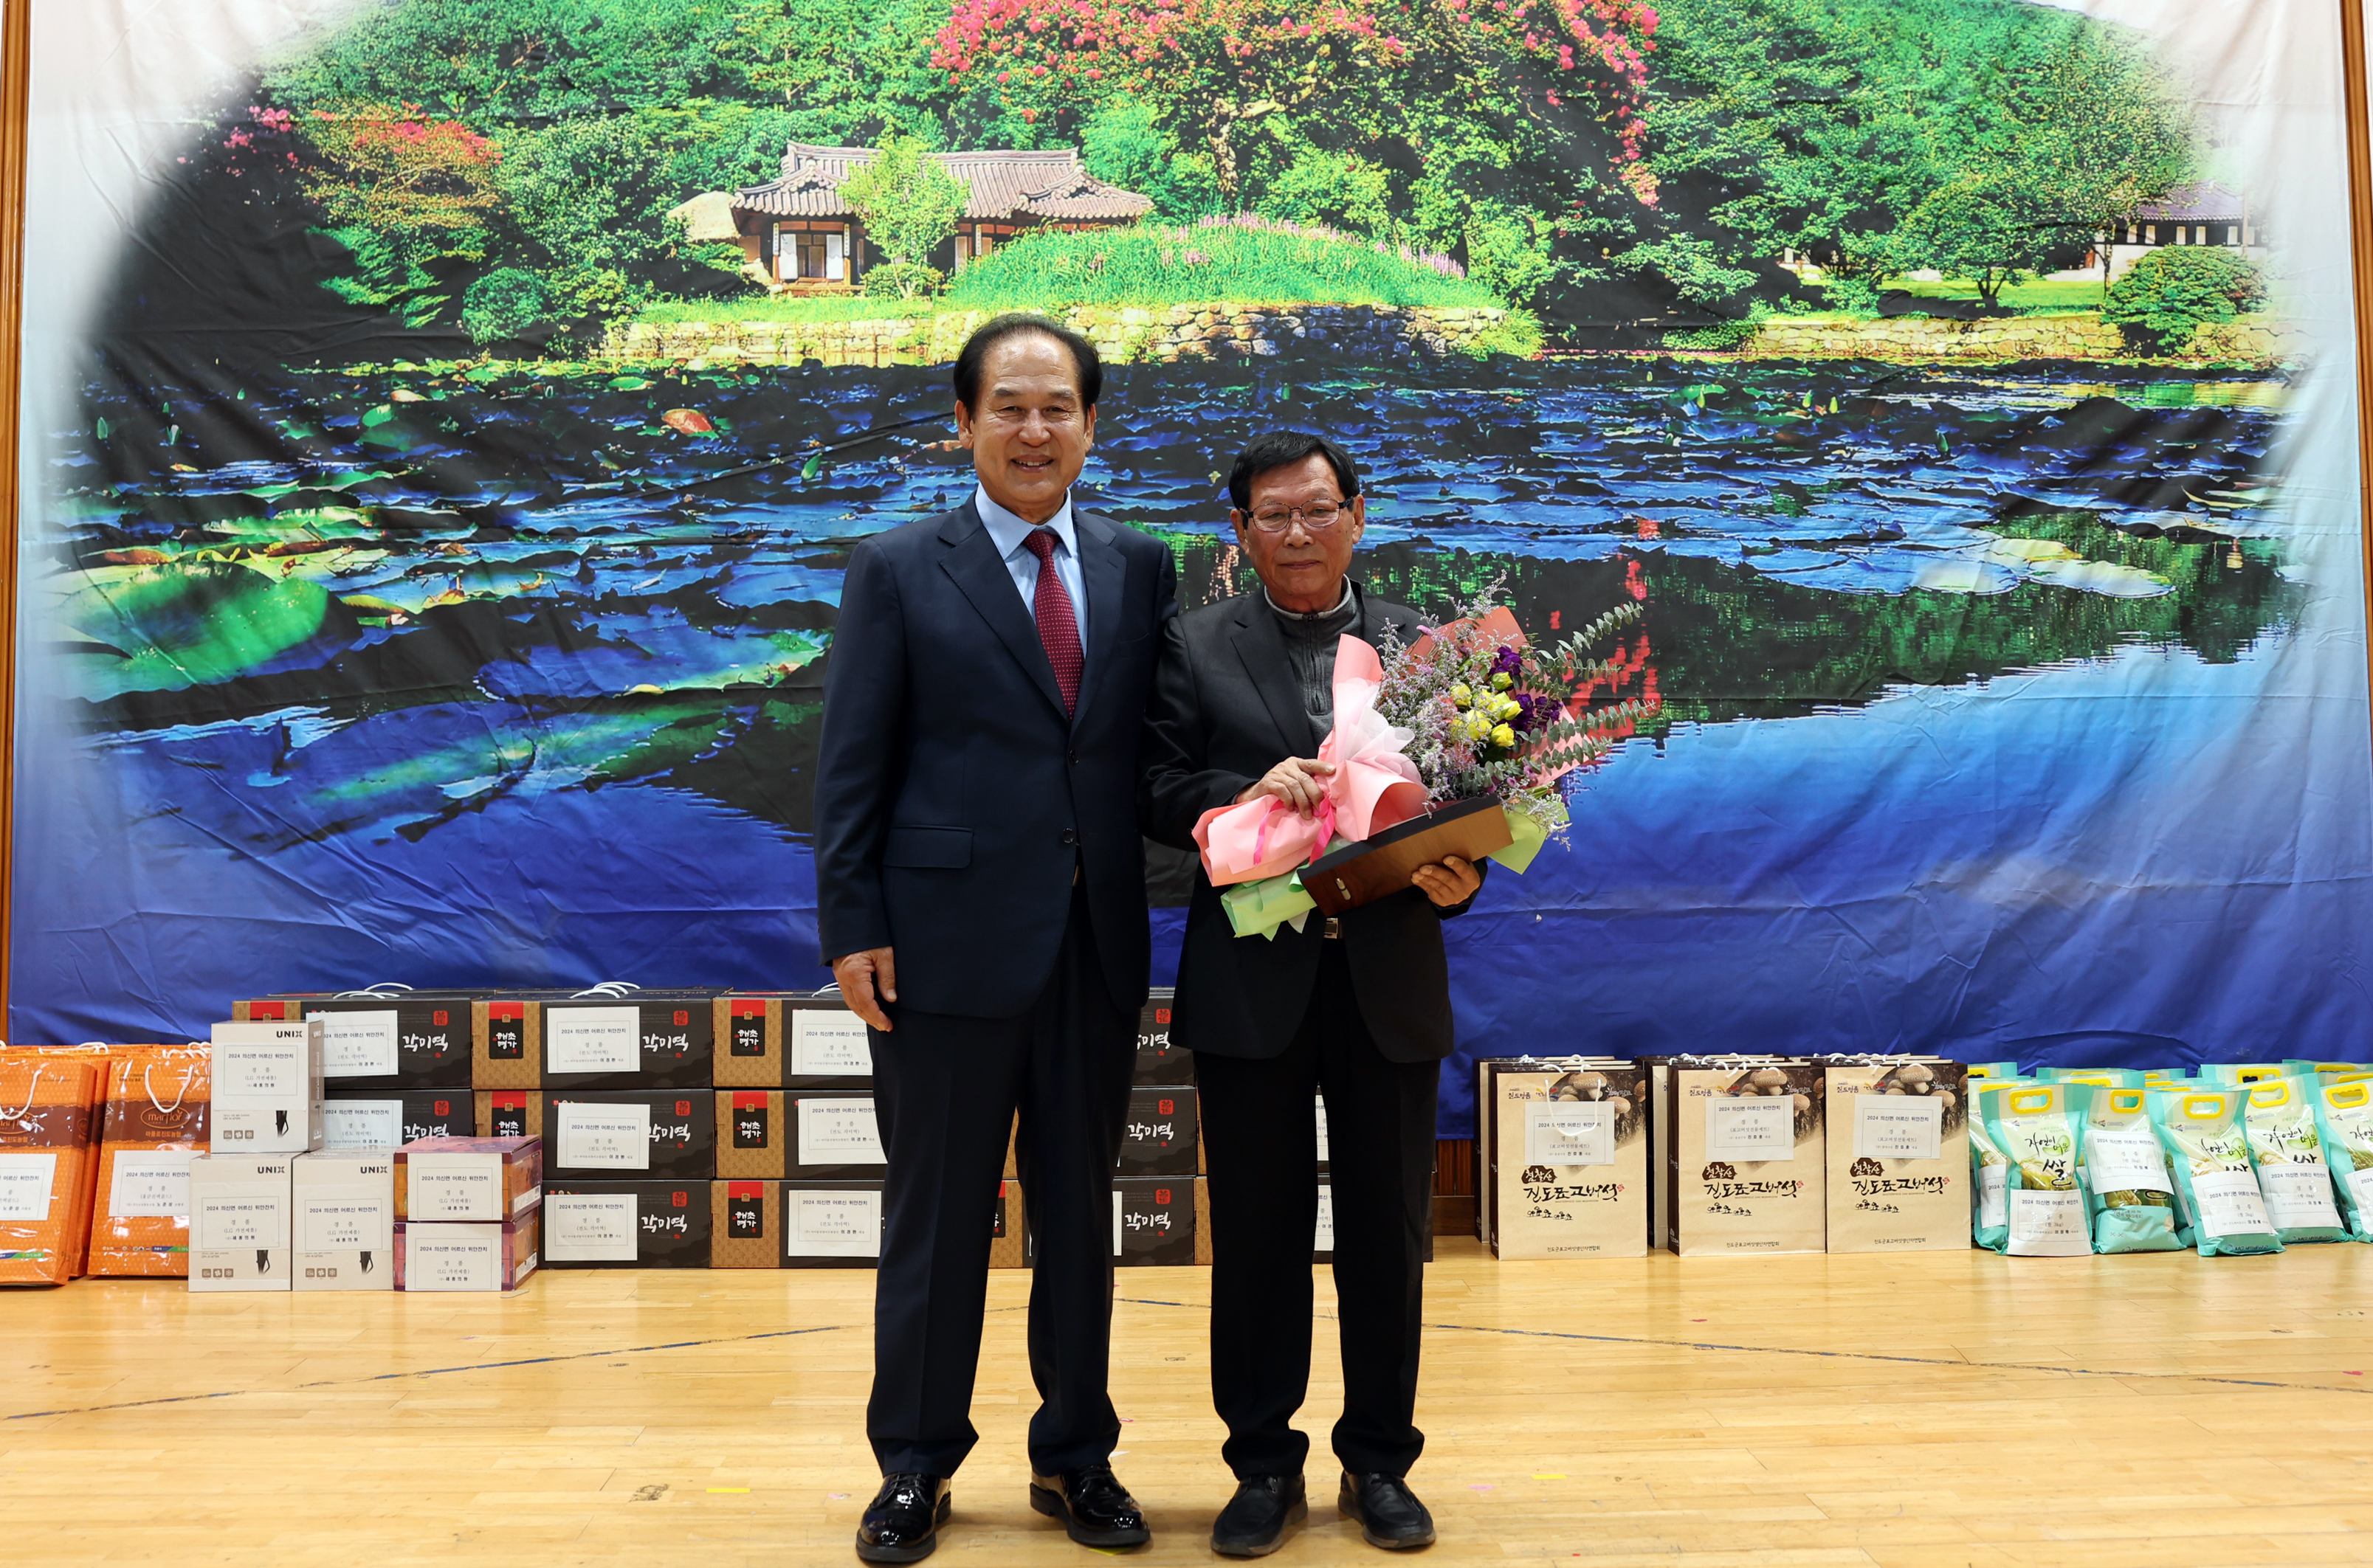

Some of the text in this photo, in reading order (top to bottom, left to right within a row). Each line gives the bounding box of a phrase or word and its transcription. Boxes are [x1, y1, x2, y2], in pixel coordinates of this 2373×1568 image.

[402, 1033, 449, 1052] 각미역
[496, 1032, 516, 1040] 해초
[642, 1033, 689, 1052] 각미역
[737, 1029, 758, 1038] 해초
[498, 1120, 519, 1130] 해초
[740, 1122, 761, 1130] 해초
[1128, 1122, 1174, 1141] 각미역
[2042, 1158, 2072, 1187] 쌀
[1523, 1184, 1618, 1203] 진도표고버섯
[1704, 1180, 1797, 1199] 진도표고버섯
[1851, 1176, 1943, 1196] 진도표고버섯
[641, 1214, 687, 1233] 각미역
[735, 1211, 756, 1219] 해초
[1125, 1212, 1171, 1231] 각미역
